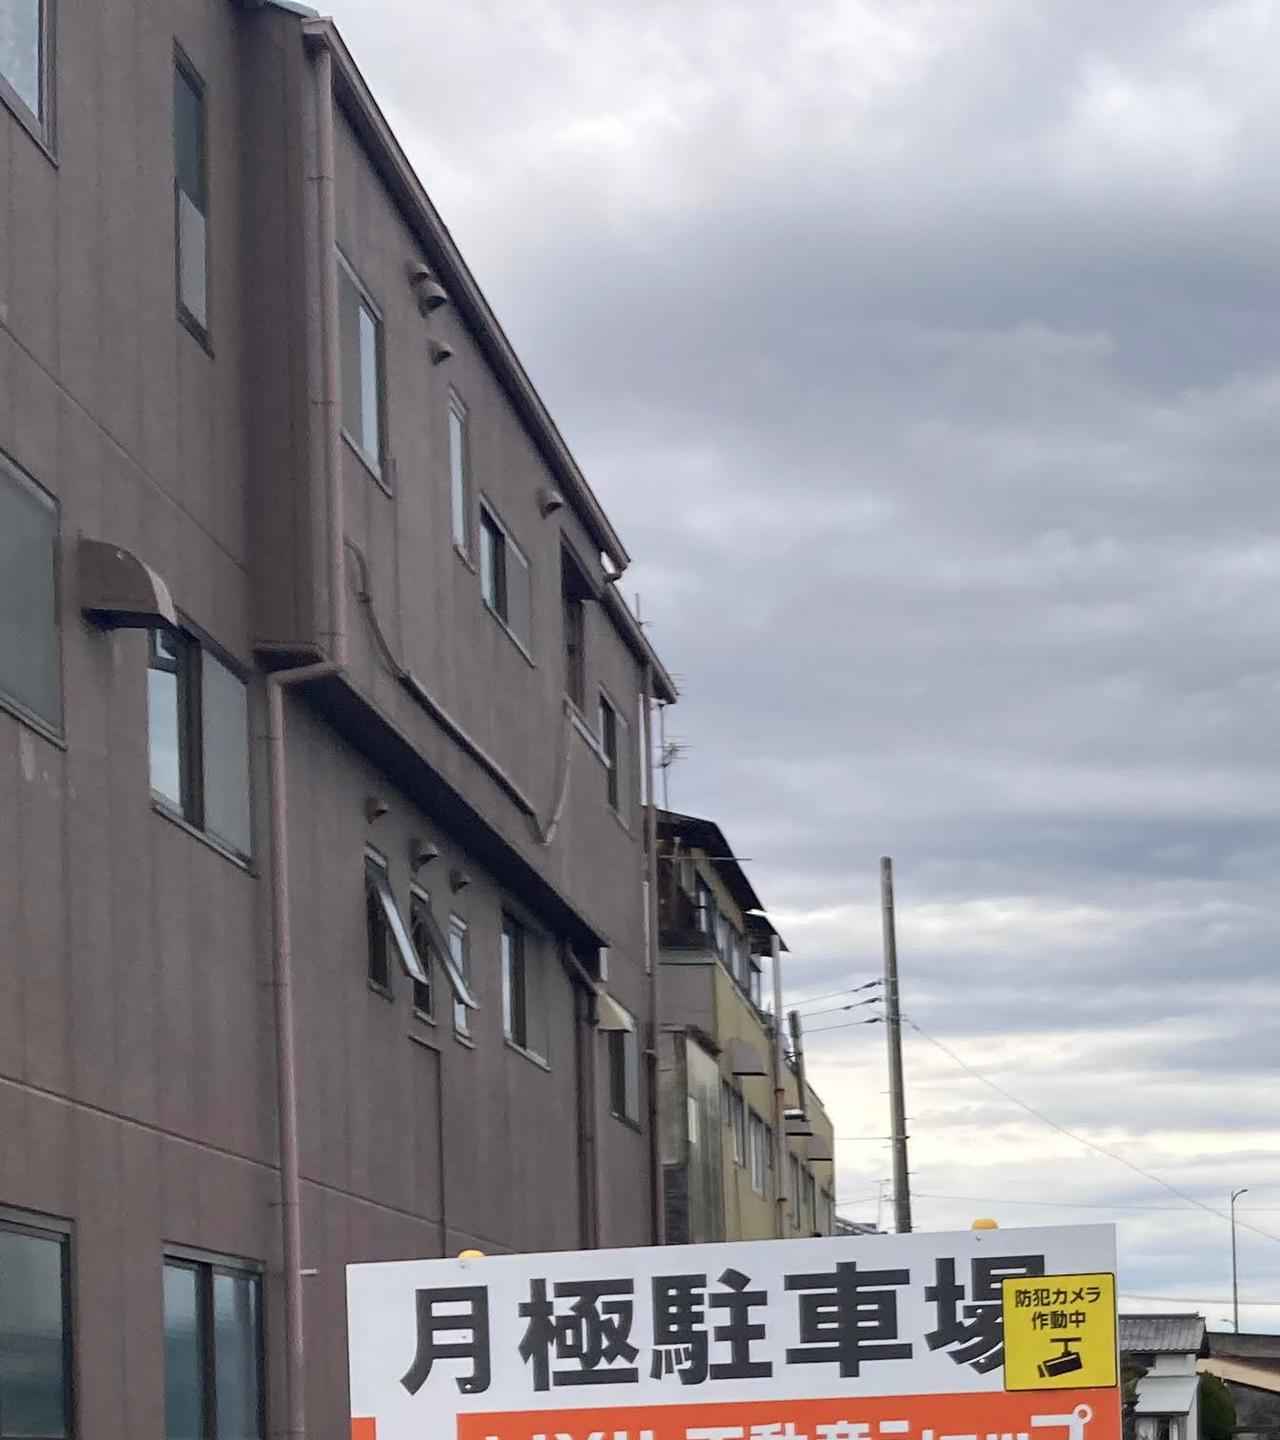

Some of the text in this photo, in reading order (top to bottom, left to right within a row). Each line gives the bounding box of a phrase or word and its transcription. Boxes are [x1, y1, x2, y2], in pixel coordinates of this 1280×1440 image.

[1014, 1286, 1102, 1309] 防犯カメラ
[1031, 1309, 1086, 1331] 作動中
